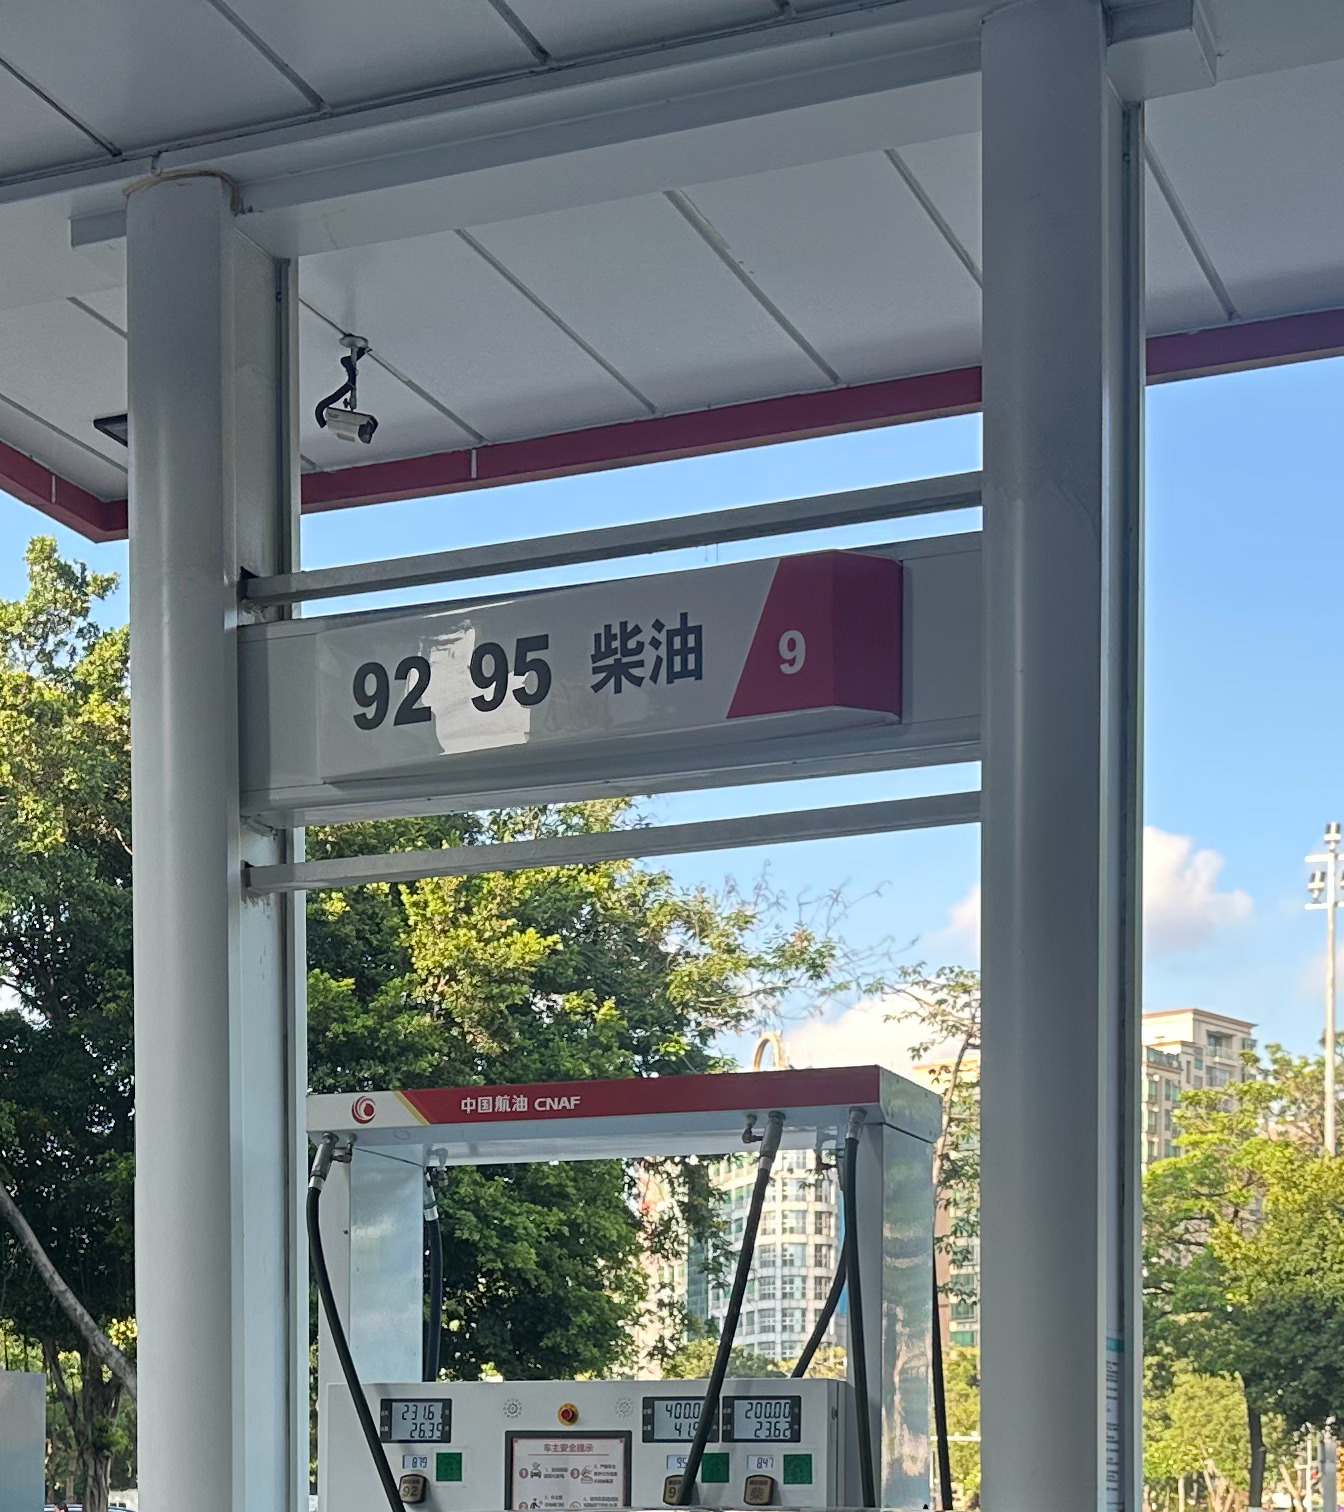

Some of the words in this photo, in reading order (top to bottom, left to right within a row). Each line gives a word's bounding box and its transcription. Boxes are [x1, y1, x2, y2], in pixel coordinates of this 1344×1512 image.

[778, 630, 807, 675] 9
[352, 656, 432, 731] 92
[469, 634, 553, 713] 95
[590, 612, 703, 696] 柴油
[461, 1094, 528, 1114] 中国航油
[534, 1096, 581, 1111] CNAF
[401, 1404, 443, 1421] 231.6
[665, 1402, 703, 1419] 400.0
[674, 1421, 699, 1438] 41.9
[402, 1485, 418, 1497] 92
